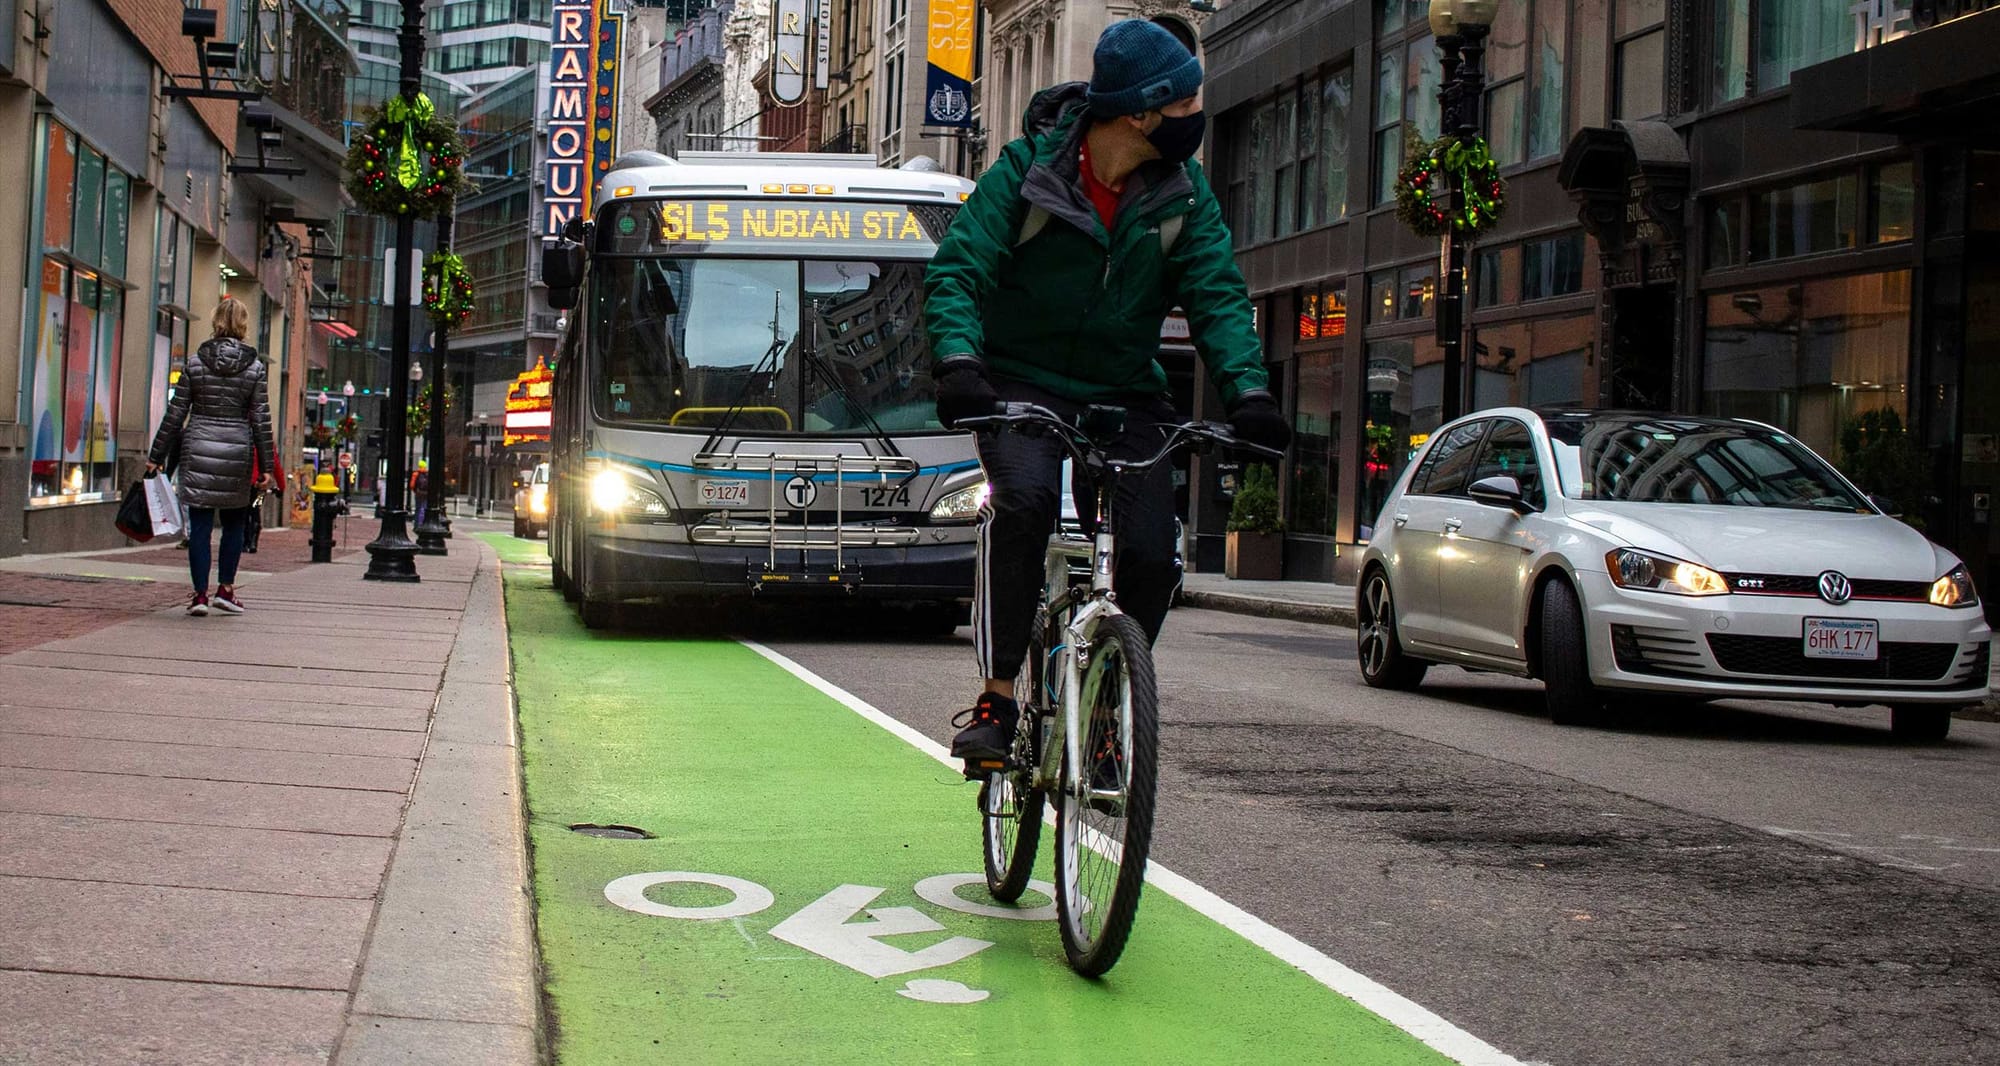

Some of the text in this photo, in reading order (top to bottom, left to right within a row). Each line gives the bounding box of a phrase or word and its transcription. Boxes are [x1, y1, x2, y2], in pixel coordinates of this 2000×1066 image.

[931, 0, 956, 50] SU
[550, 0, 584, 235] RAMOUN
[662, 203, 922, 241] SL5 NUBIAN STA
[717, 486, 746, 500] 1274
[789, 484, 811, 504] T
[859, 486, 912, 507] 1274
[1737, 579, 1765, 589] GTI
[1808, 629, 1873, 650] 6HK 177
